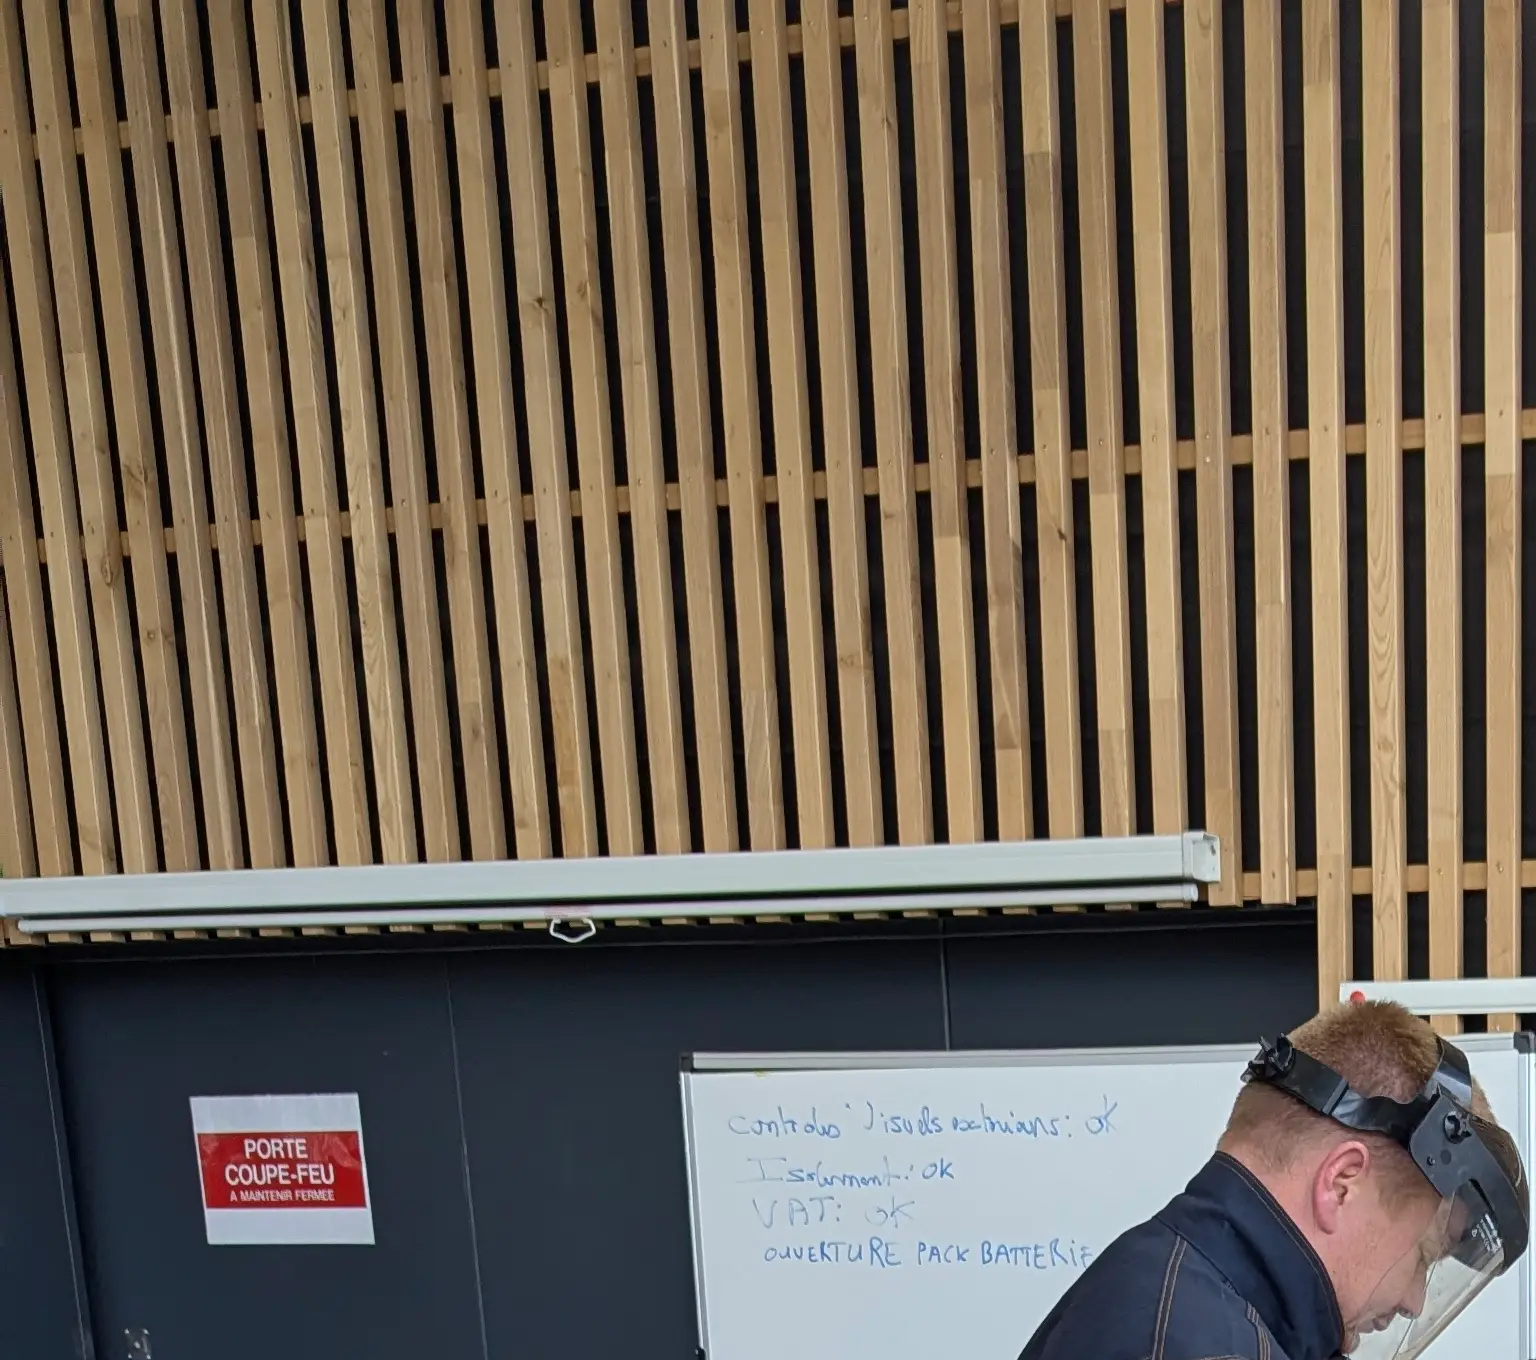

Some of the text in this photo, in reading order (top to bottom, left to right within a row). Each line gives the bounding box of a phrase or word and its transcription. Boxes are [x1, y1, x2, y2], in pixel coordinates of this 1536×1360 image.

[244, 1138, 308, 1159] PORTE
[225, 1163, 335, 1186] COUPE-FEU
[230, 1190, 238, 1202] A
[240, 1189, 293, 1202] MAINTENIR
[917, 1240, 970, 1266] PACK
